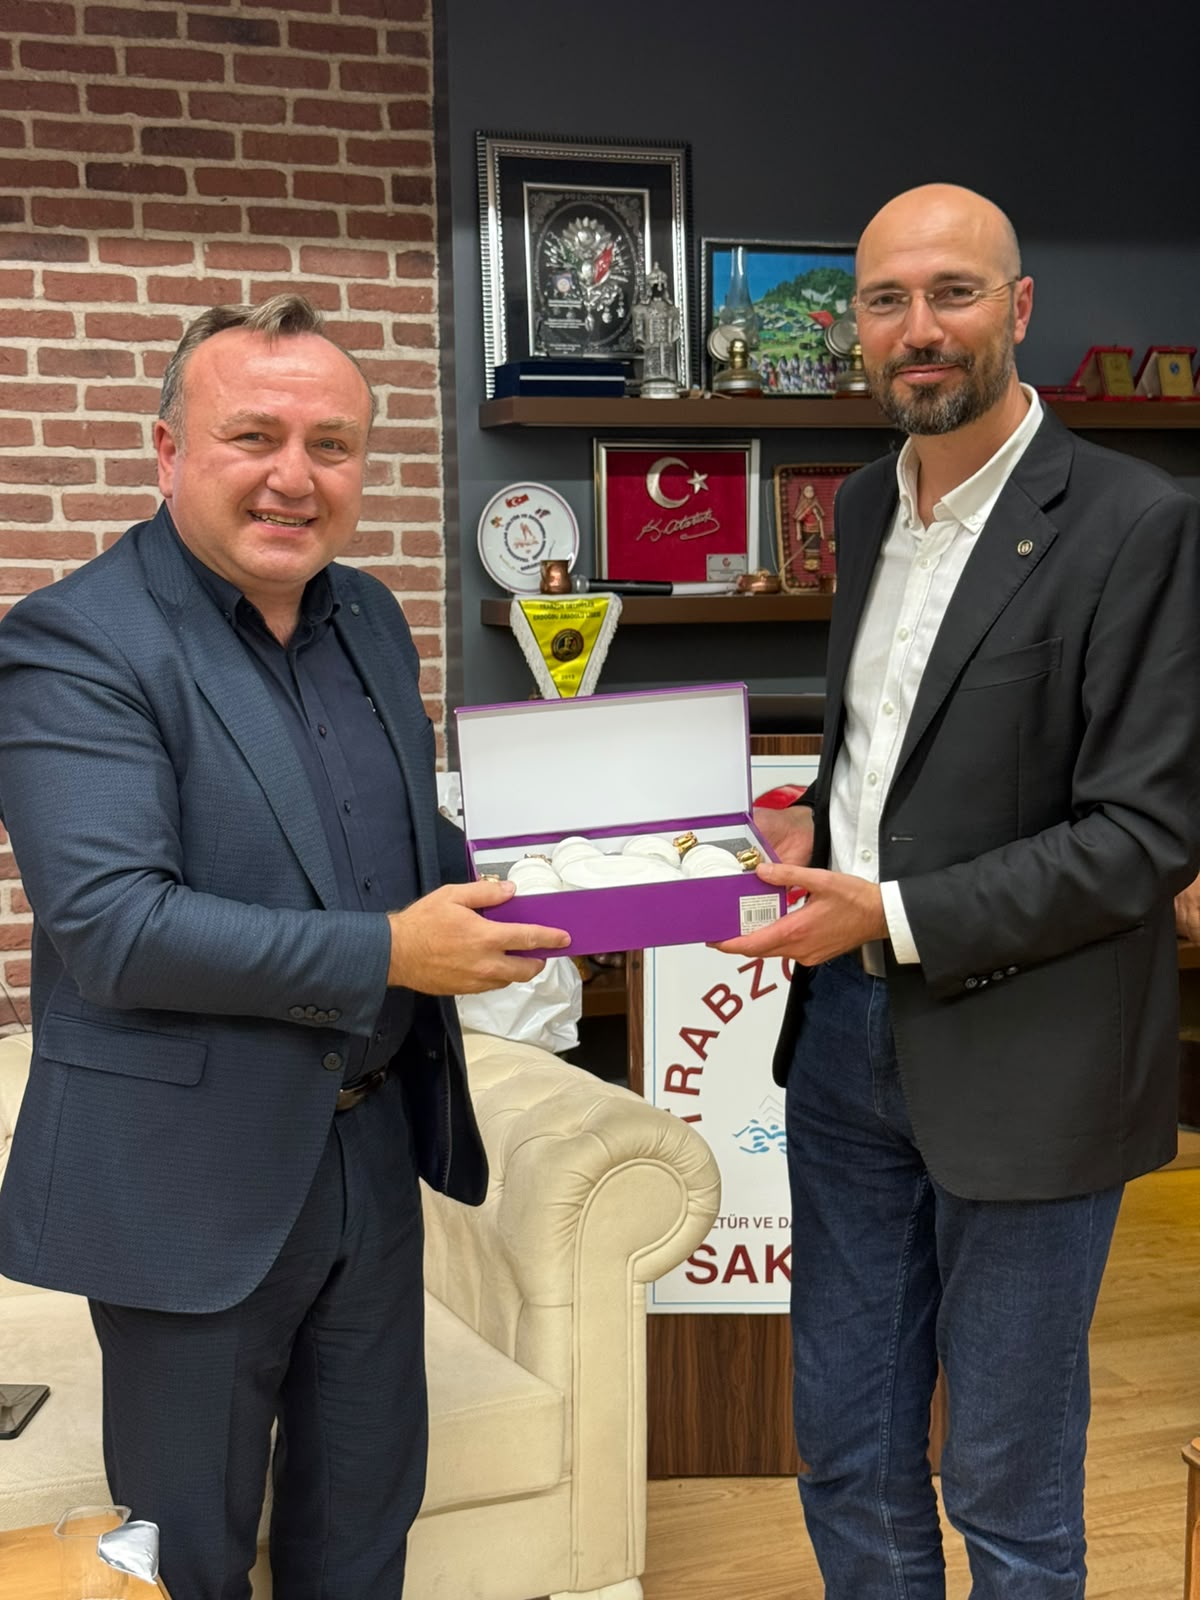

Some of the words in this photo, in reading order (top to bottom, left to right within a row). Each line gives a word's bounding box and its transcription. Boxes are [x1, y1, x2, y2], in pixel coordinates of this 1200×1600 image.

[712, 1213, 749, 1229] TÜR
[753, 1216, 773, 1229] VE
[778, 1216, 791, 1229] D
[685, 1244, 792, 1285] SAK
